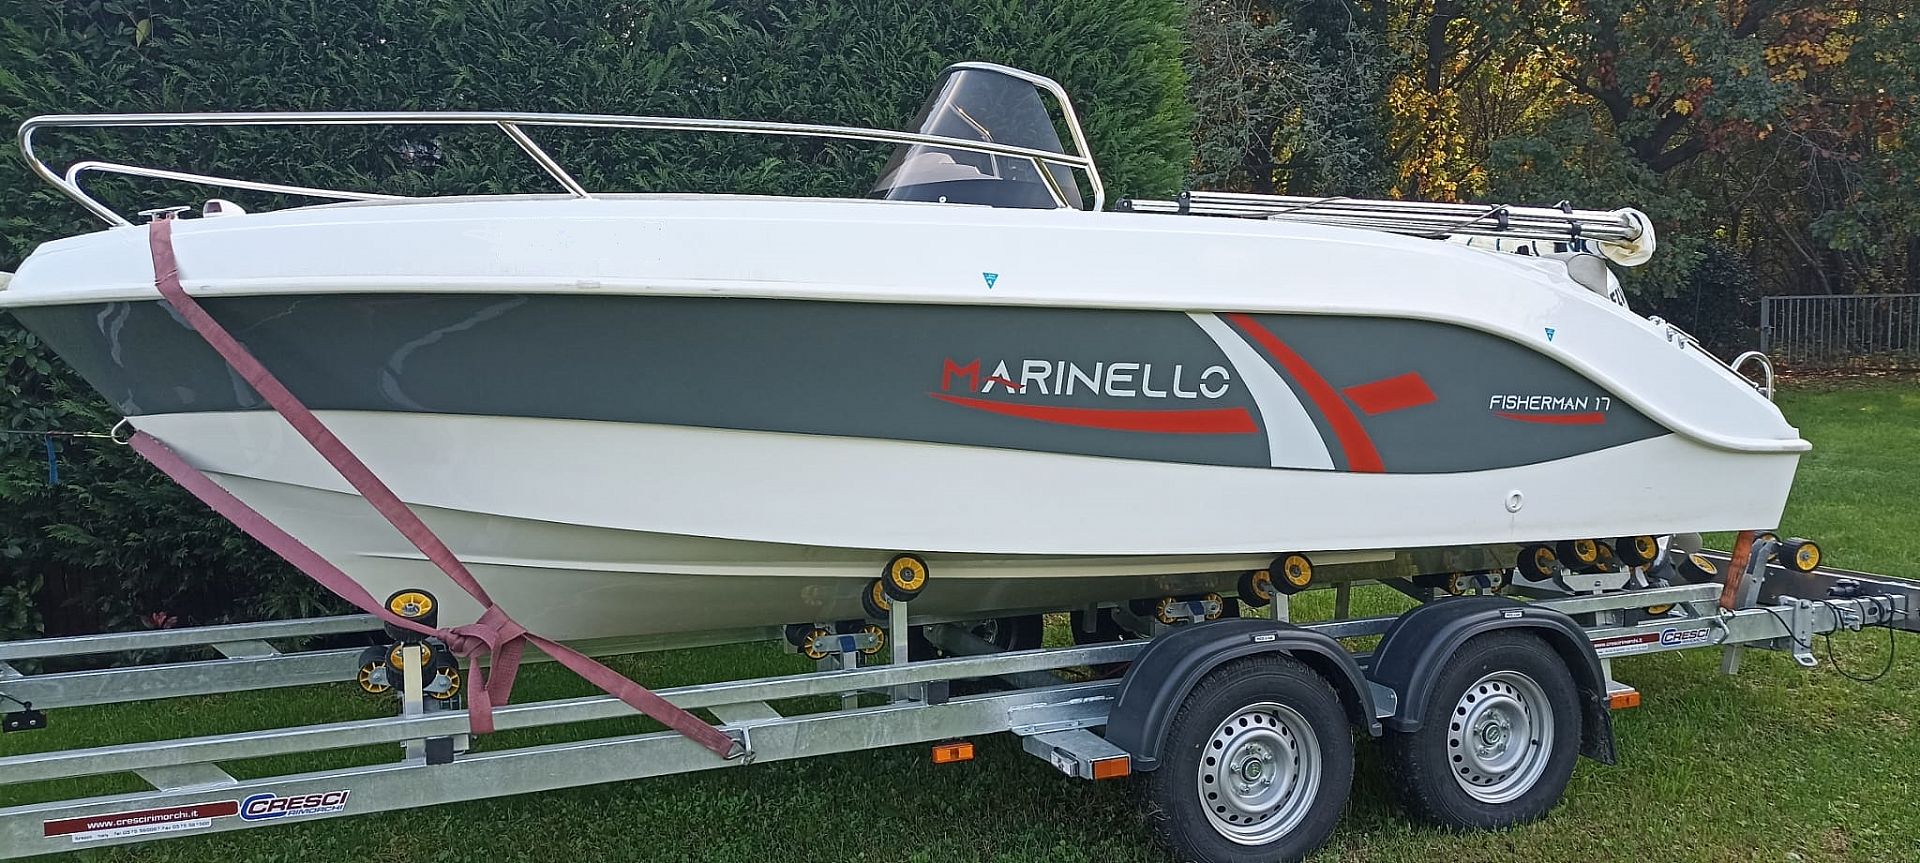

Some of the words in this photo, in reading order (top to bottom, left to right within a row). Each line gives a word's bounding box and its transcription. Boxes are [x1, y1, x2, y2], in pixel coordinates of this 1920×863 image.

[941, 357, 1230, 399] MARINELLO
[1489, 394, 1588, 411] FISHERMAN
[1595, 396, 1611, 411] 17
[1663, 628, 1709, 642] CRESCI
[243, 791, 349, 817] CRESCI
[287, 804, 344, 816] RIMORCHI
[87, 810, 199, 829] www.crescirimorchi.it
